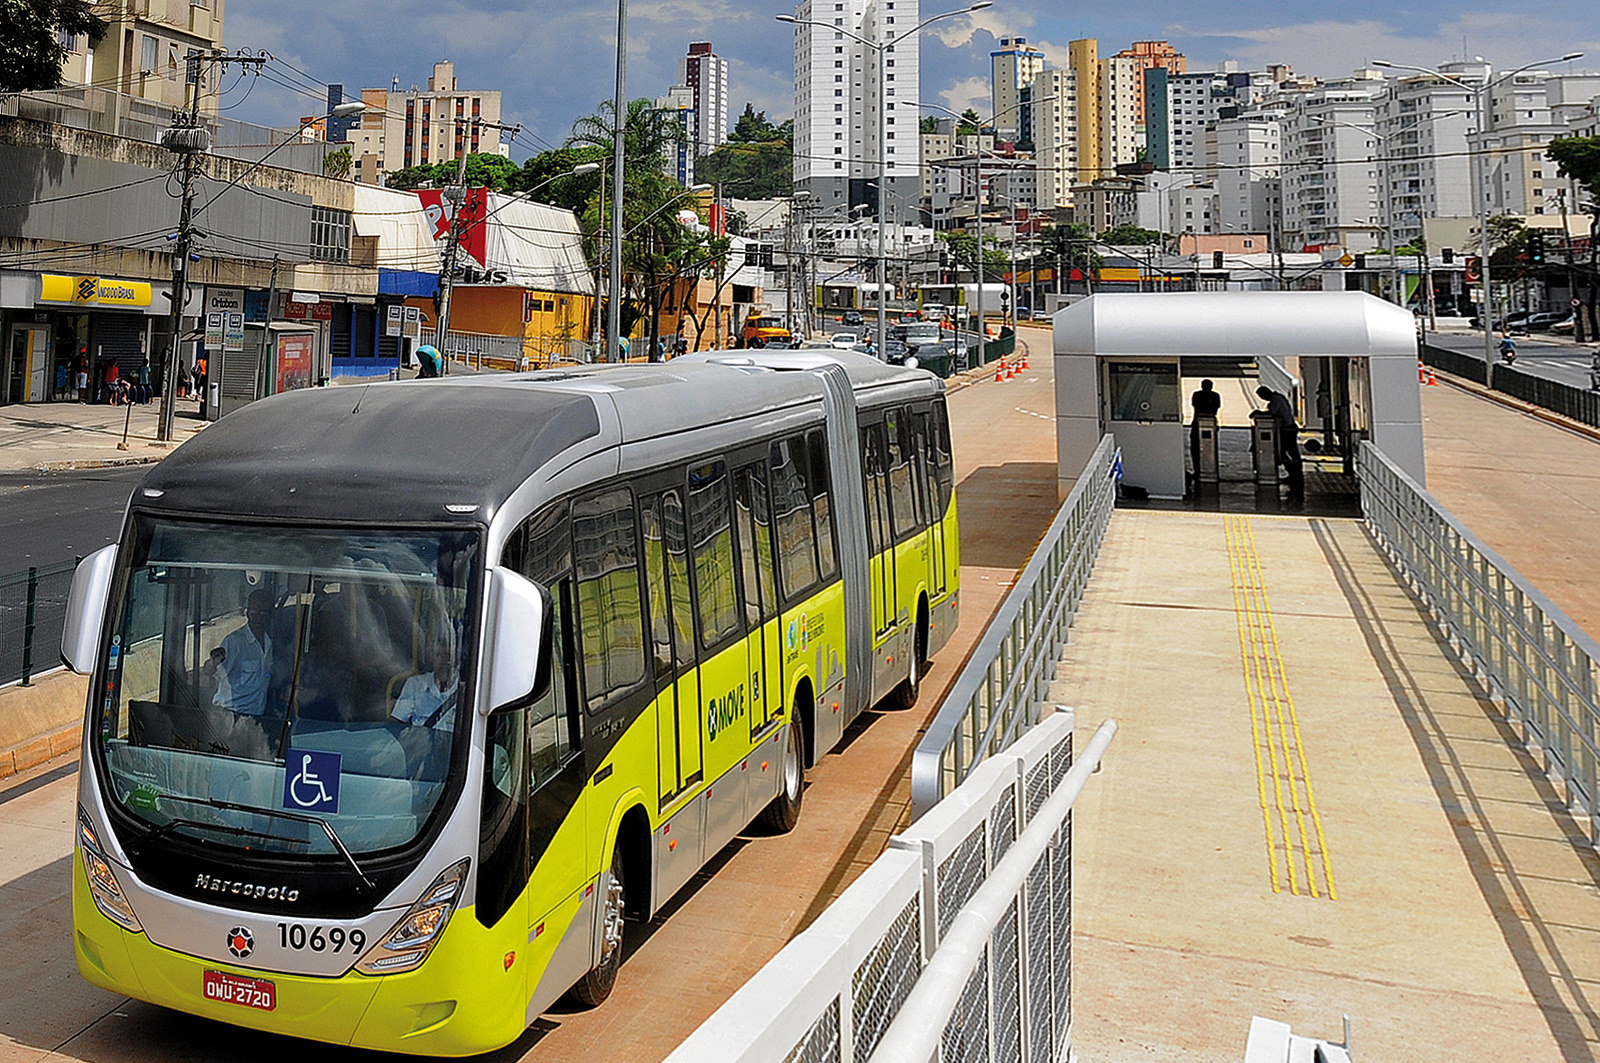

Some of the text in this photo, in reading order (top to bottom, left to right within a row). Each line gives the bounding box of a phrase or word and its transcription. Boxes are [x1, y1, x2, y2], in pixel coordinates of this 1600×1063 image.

[118, 286, 135, 299] BRASIL
[718, 683, 744, 733] MOVE
[195, 873, 299, 902] Marcopolo
[277, 922, 367, 955] 10699
